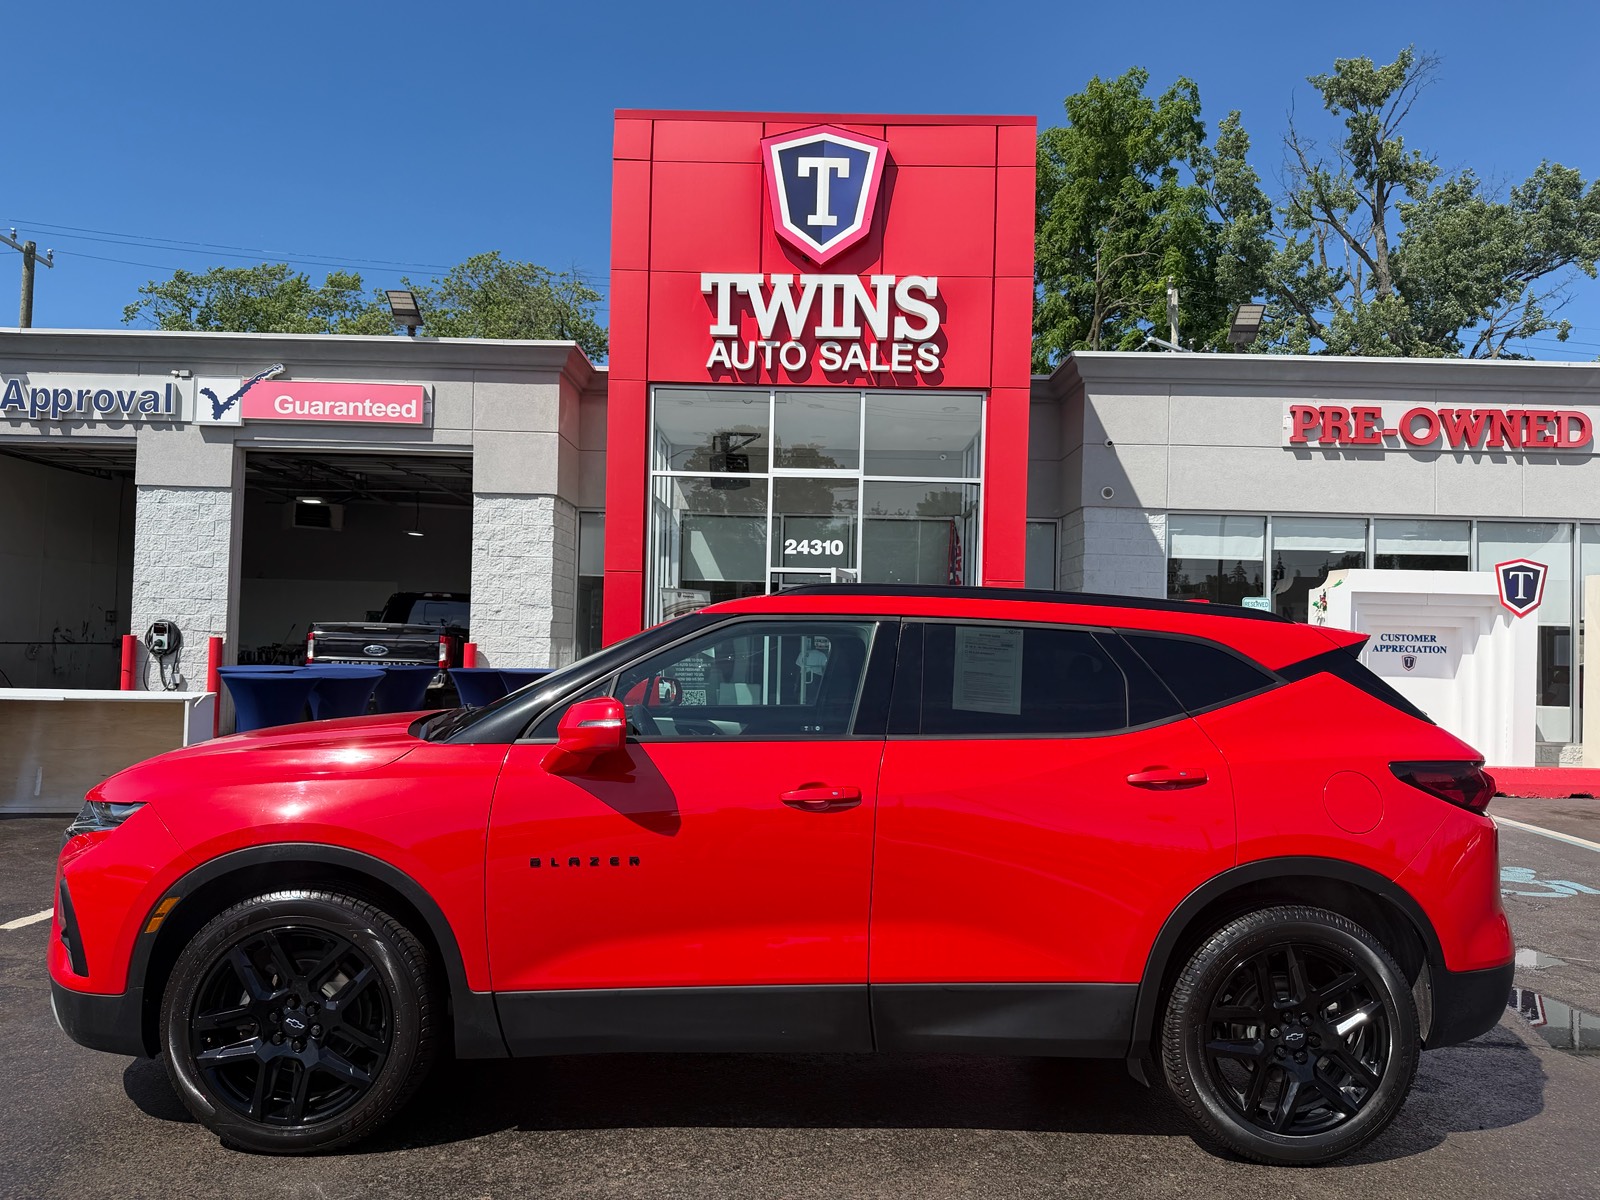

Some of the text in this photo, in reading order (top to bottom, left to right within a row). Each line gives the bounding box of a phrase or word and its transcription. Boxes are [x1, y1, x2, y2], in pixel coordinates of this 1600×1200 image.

[797, 156, 850, 226] T
[701, 272, 941, 341] TWINS
[706, 340, 941, 373] AUTO SALES
[0, 378, 417, 420] Approval Guaranteed
[1289, 405, 1593, 448] PRE-OWNED
[784, 539, 844, 555] 24310
[1508, 571, 1534, 599] T
[1372, 644, 1447, 654] APPRECIATION
[1380, 633, 1437, 643] CUSTOMER
[529, 856, 641, 868] BLAZER
